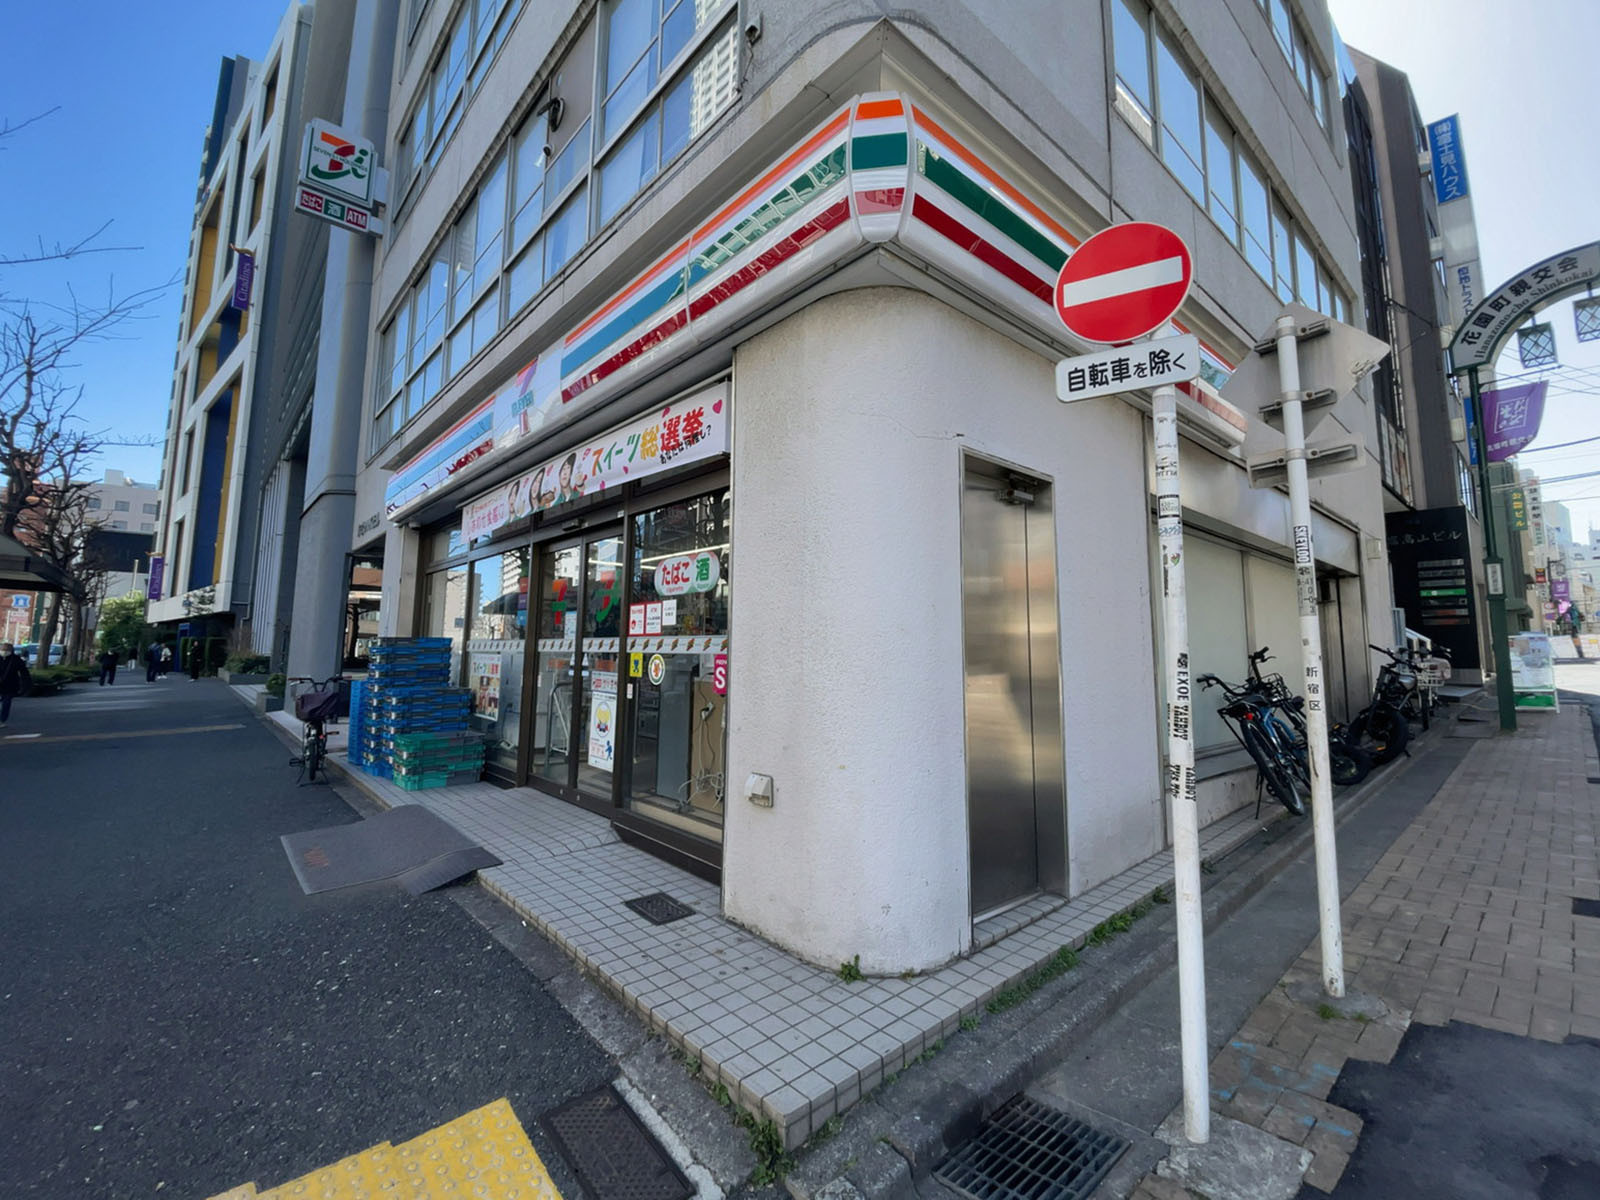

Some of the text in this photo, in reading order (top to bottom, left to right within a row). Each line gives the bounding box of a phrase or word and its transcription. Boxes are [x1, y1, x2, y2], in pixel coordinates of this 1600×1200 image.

[346, 210, 367, 227] ATM
[1460, 256, 1579, 346] 花園町親交会
[1474, 268, 1594, 359] Hanazono-cho Shinkokai
[1068, 349, 1186, 392] 自転車を除く
[591, 406, 704, 477] スイーツ総選挙
[1294, 526, 1311, 563] SKEYLOO
[661, 561, 690, 586] たばこ
[695, 557, 710, 582] 酒
[1305, 666, 1321, 711] 新宿区
[1173, 704, 1189, 741] YAHBOY
[1185, 766, 1197, 802] YAHBOY
